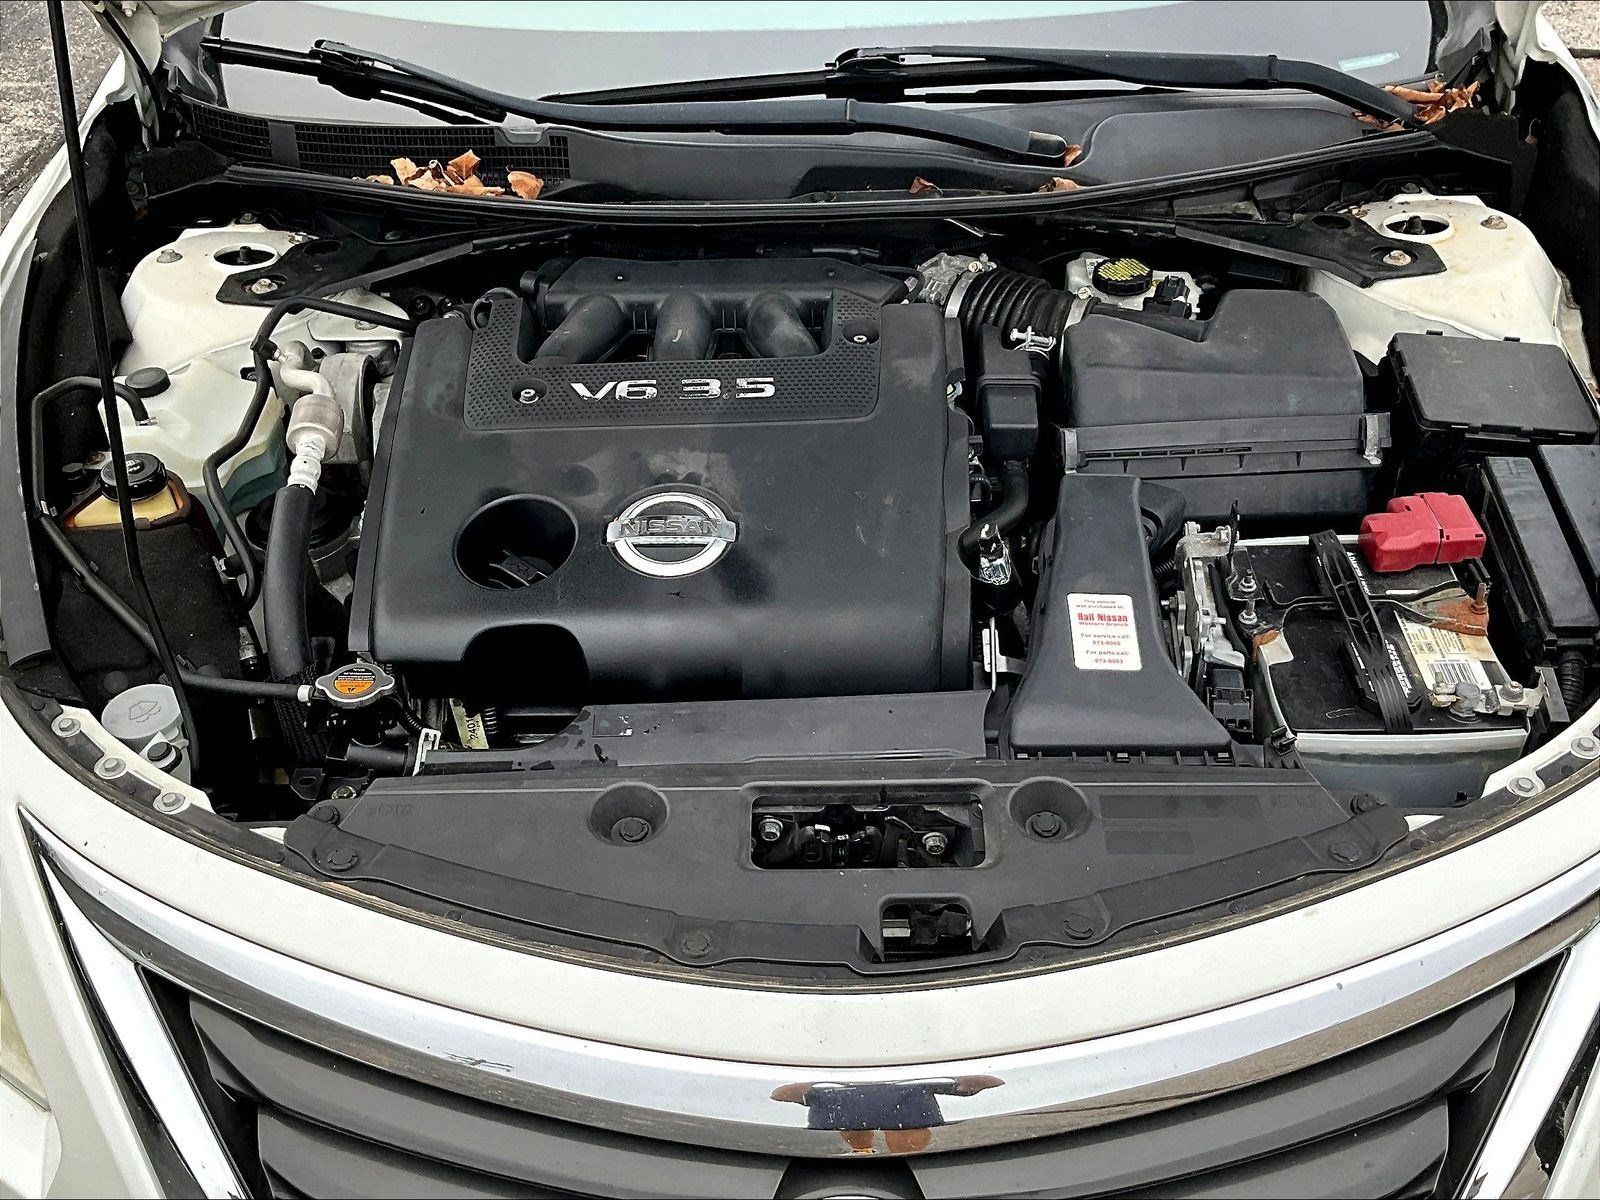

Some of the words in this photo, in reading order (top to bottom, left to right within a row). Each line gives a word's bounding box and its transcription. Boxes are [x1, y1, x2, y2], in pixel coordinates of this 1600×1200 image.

[570, 379, 658, 401] V6
[679, 377, 776, 400] 3.5
[620, 519, 720, 535] NISSAN
[1077, 612, 1095, 621] Hall
[1097, 613, 1128, 622] Nissan
